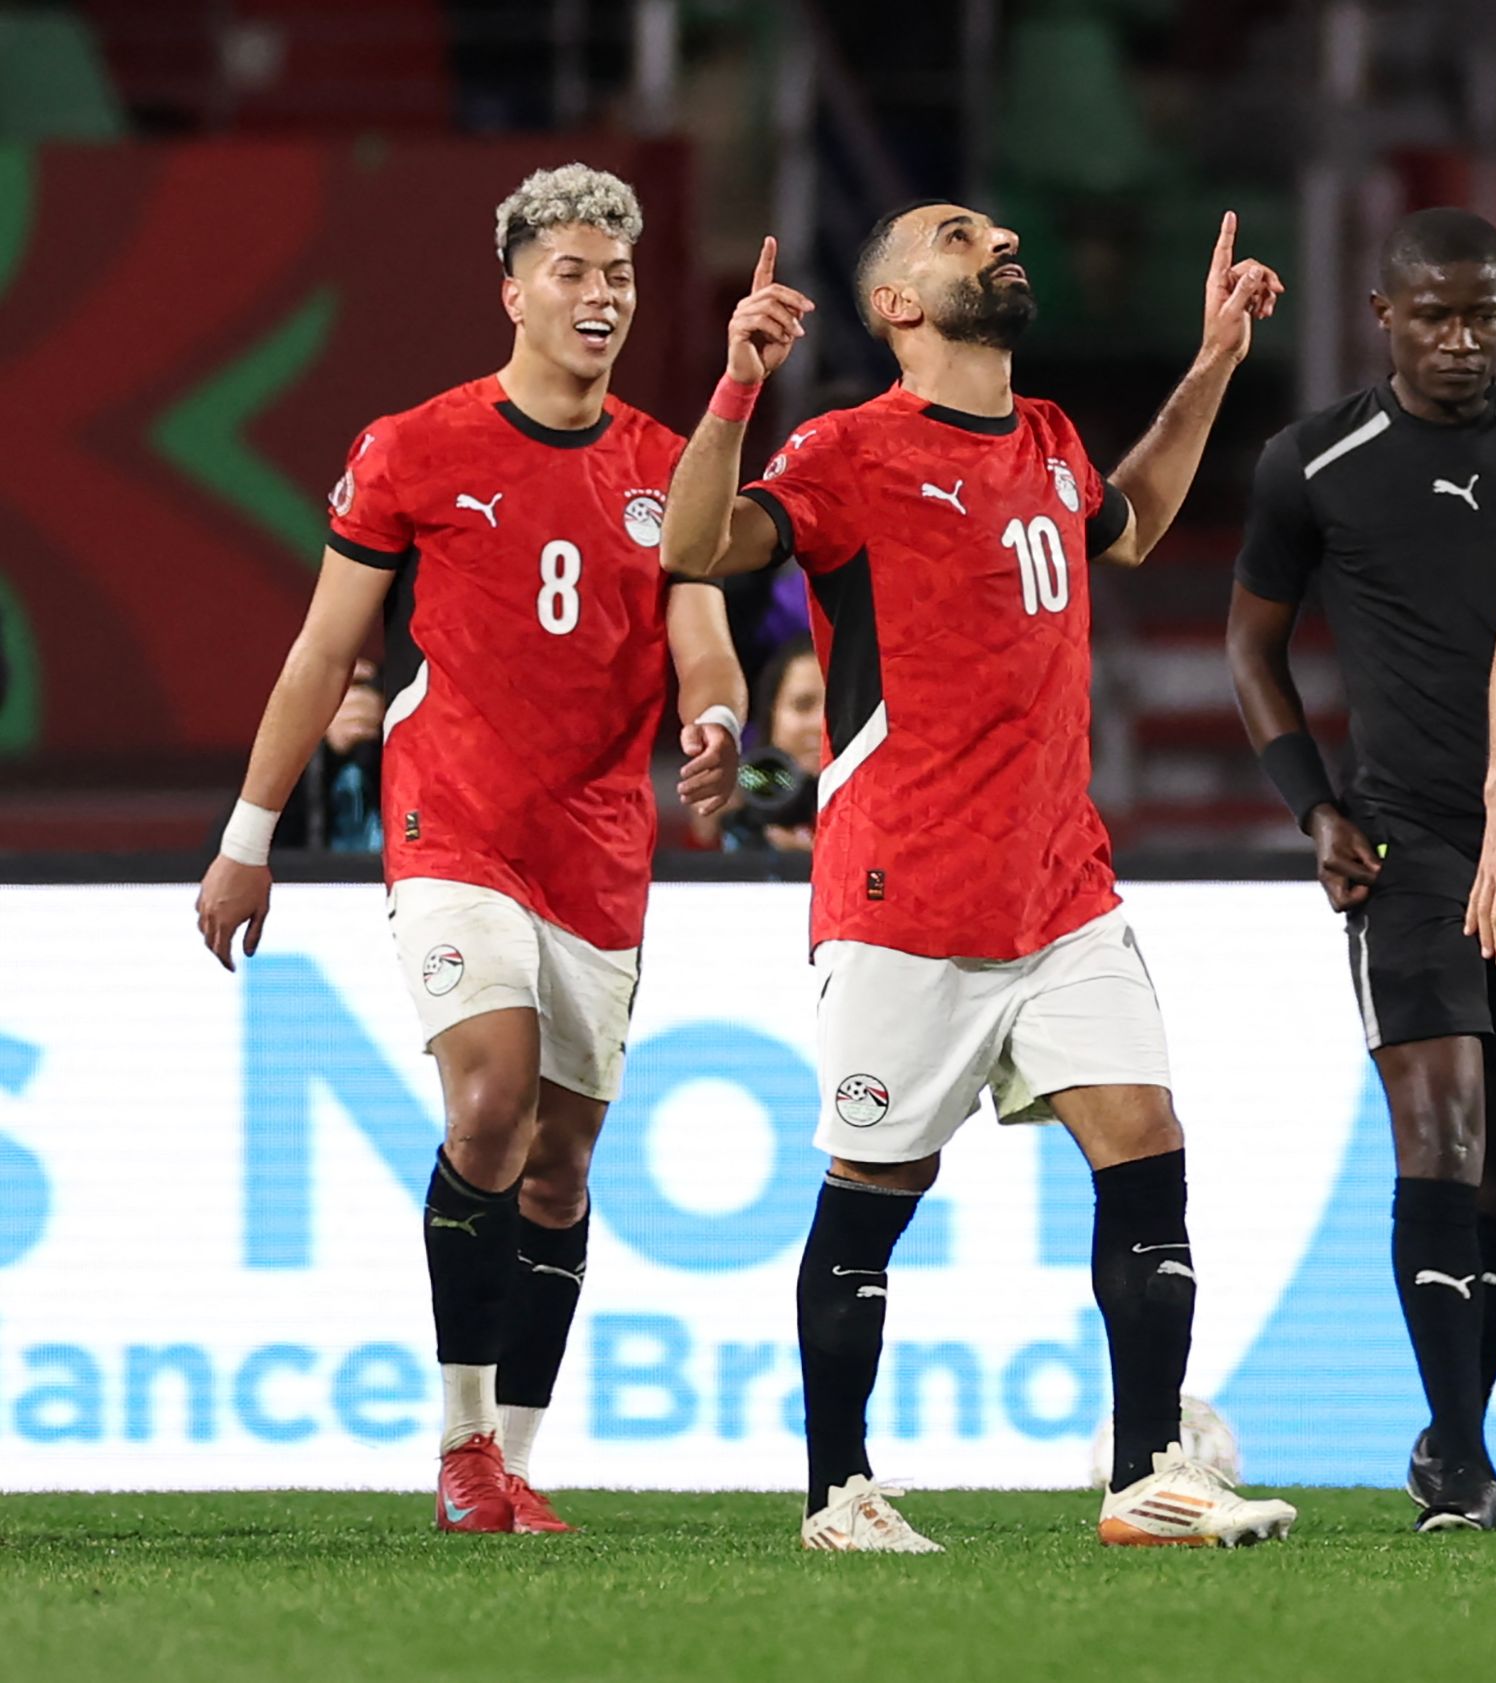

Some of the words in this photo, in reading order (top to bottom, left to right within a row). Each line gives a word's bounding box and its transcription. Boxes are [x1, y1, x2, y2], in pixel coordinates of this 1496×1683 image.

[537, 540, 581, 635] 8
[1001, 515, 1069, 615] 10
[14, 1340, 430, 1443] ance
